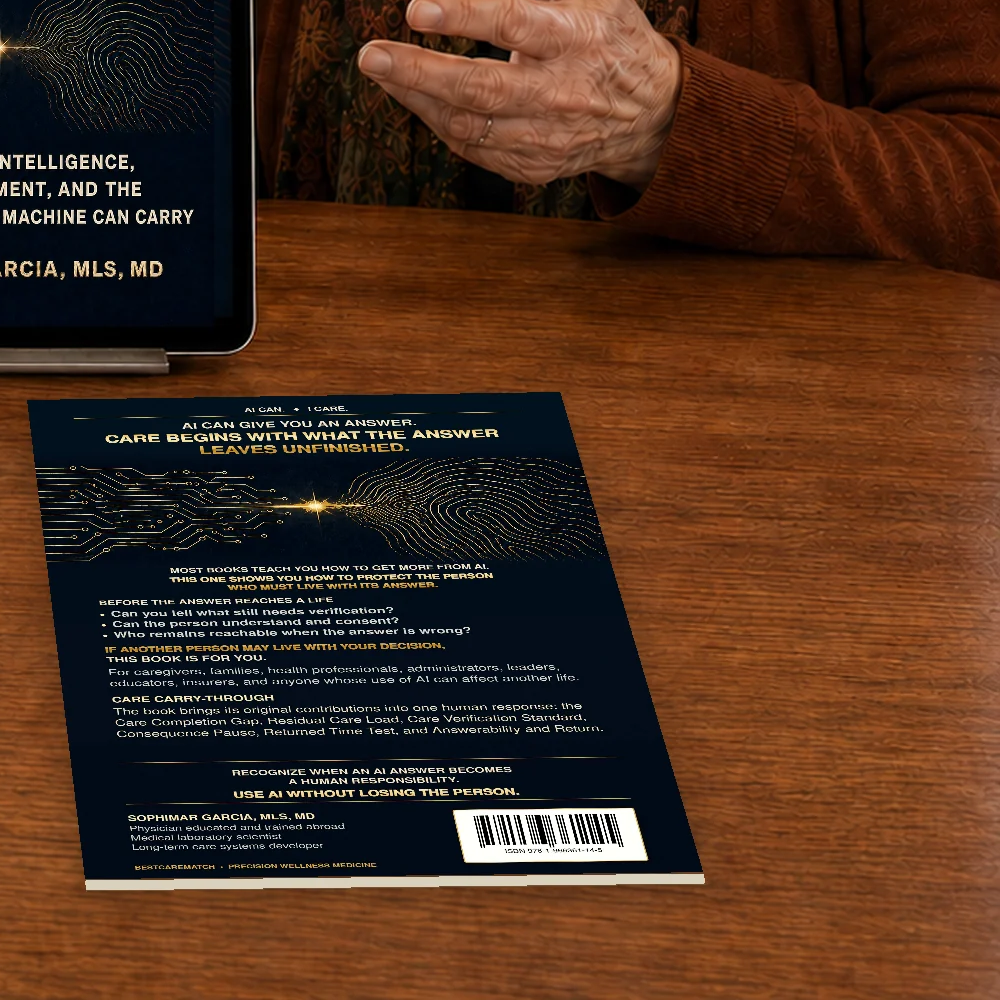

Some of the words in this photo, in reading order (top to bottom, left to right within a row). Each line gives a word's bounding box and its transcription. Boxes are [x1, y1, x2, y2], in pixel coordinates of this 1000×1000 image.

[58, 182, 97, 196] AND
[106, 182, 141, 196] THE
[3, 209, 86, 224] MACHINE
[93, 210, 128, 224] CAN
[136, 209, 193, 224] CARRY
[74, 261, 123, 280] MLS,
[131, 261, 163, 277] MD
[313, 404, 350, 413] CARE.
[181, 422, 198, 430] AI
[201, 421, 235, 430] CAN
[238, 420, 276, 429] GIVE
[279, 420, 313, 428] YOU
[317, 420, 340, 428] AN
[344, 418, 417, 427] ANSWER.
[104, 433, 161, 444] CARE
[165, 432, 243, 443] BEGINS
[245, 431, 298, 442] WITH
[301, 430, 361, 441] WHAT
[364, 430, 407, 440] THE
[411, 428, 500, 439] ANSWER
[199, 444, 278, 455] LEAVES
[282, 442, 410, 454] UNFINISHED.
[228, 575, 275, 583] SHOWS
[304, 574, 335, 582] HOW
[356, 573, 413, 581] PROTECT
[442, 572, 494, 580] PERSON
[259, 583, 294, 591] MUST
[325, 582, 358, 590] WITH
[382, 581, 439, 589] ANSWER.
[234, 597, 293, 605] REACHES
[110, 610, 138, 618] Can
[141, 611, 168, 619] you
[195, 609, 230, 617] what
[233, 608, 259, 616] still
[262, 607, 305, 616] needs
[308, 606, 394, 615] verification?
[112, 620, 140, 628] Can
[143, 620, 166, 628] the
[169, 620, 219, 629] person
[221, 618, 302, 627] understand
[305, 617, 331, 626] and
[335, 616, 400, 625] consent?
[113, 630, 146, 639] Who
[149, 630, 206, 638] remains
[209, 629, 278, 637] reachable
[281, 628, 319, 636] when
[322, 628, 345, 636] the
[348, 628, 399, 636] answer
[402, 627, 416, 635] is
[418, 626, 471, 636] wrong?
[104, 646, 117, 654] IF
[120, 645, 183, 653] ANOTHER
[185, 644, 240, 653] PERSON
[241, 644, 270, 652] MAY
[272, 643, 302, 651] LIVE
[303, 643, 338, 651] WITH
[339, 643, 377, 651] YOUR
[379, 642, 446, 650] DECISION,
[105, 655, 138, 663] THIS
[141, 655, 182, 663] BOOK
[201, 654, 231, 662] FOR
[233, 654, 267, 662] YOU.
[461, 674, 499, 683] affect
[111, 695, 151, 704] CARE
[154, 694, 275, 703] CARRY-THROUGH
[441, 703, 488, 712] human
[151, 717, 227, 728] Completion
[263, 727, 326, 736] Returned
[231, 768, 307, 777] RECOGNIZE
[308, 768, 349, 776] WHEN
[373, 767, 386, 775] AI
[389, 767, 446, 775] ANSWER
[448, 766, 513, 774] BECOMES
[300, 777, 349, 785] HUMAN
[351, 776, 460, 785] RESPONSIBILITY.
[233, 790, 265, 799] USE
[268, 790, 283, 799] AI
[285, 789, 356, 798] WITHOUT
[358, 788, 416, 798] LOSING
[418, 788, 450, 797] THE
[452, 787, 520, 796] PERSON.
[127, 814, 198, 822] SOPHIMAR
[201, 813, 257, 822] GARCIA,
[259, 812, 292, 821] MLS,
[294, 812, 316, 820] MD
